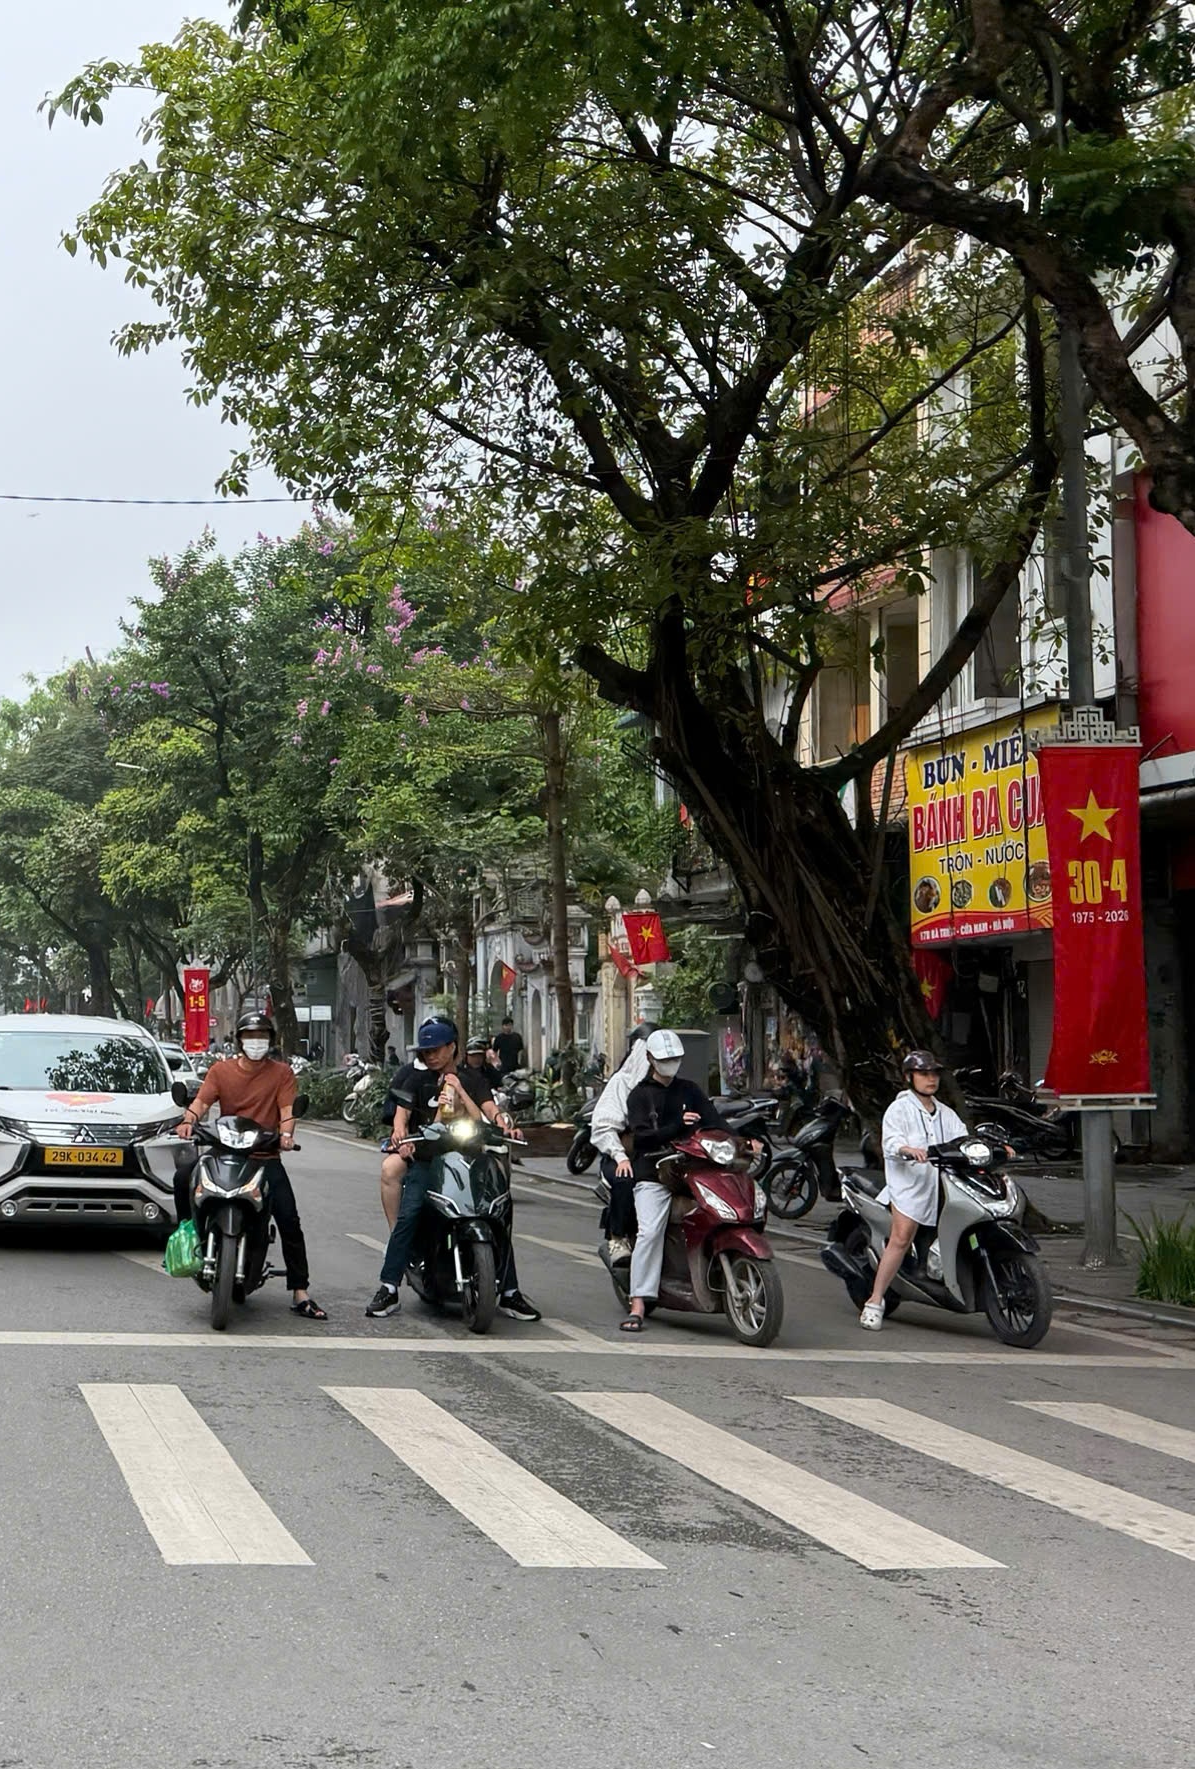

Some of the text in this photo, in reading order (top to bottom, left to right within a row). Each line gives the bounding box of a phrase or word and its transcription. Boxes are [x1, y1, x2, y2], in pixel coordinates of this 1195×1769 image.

[1067, 858, 1128, 905] 30-4
[1071, 911, 1095, 924] 1975
[189, 995, 206, 1008] 1-5
[52, 1150, 117, 1164] 29K-034.42
